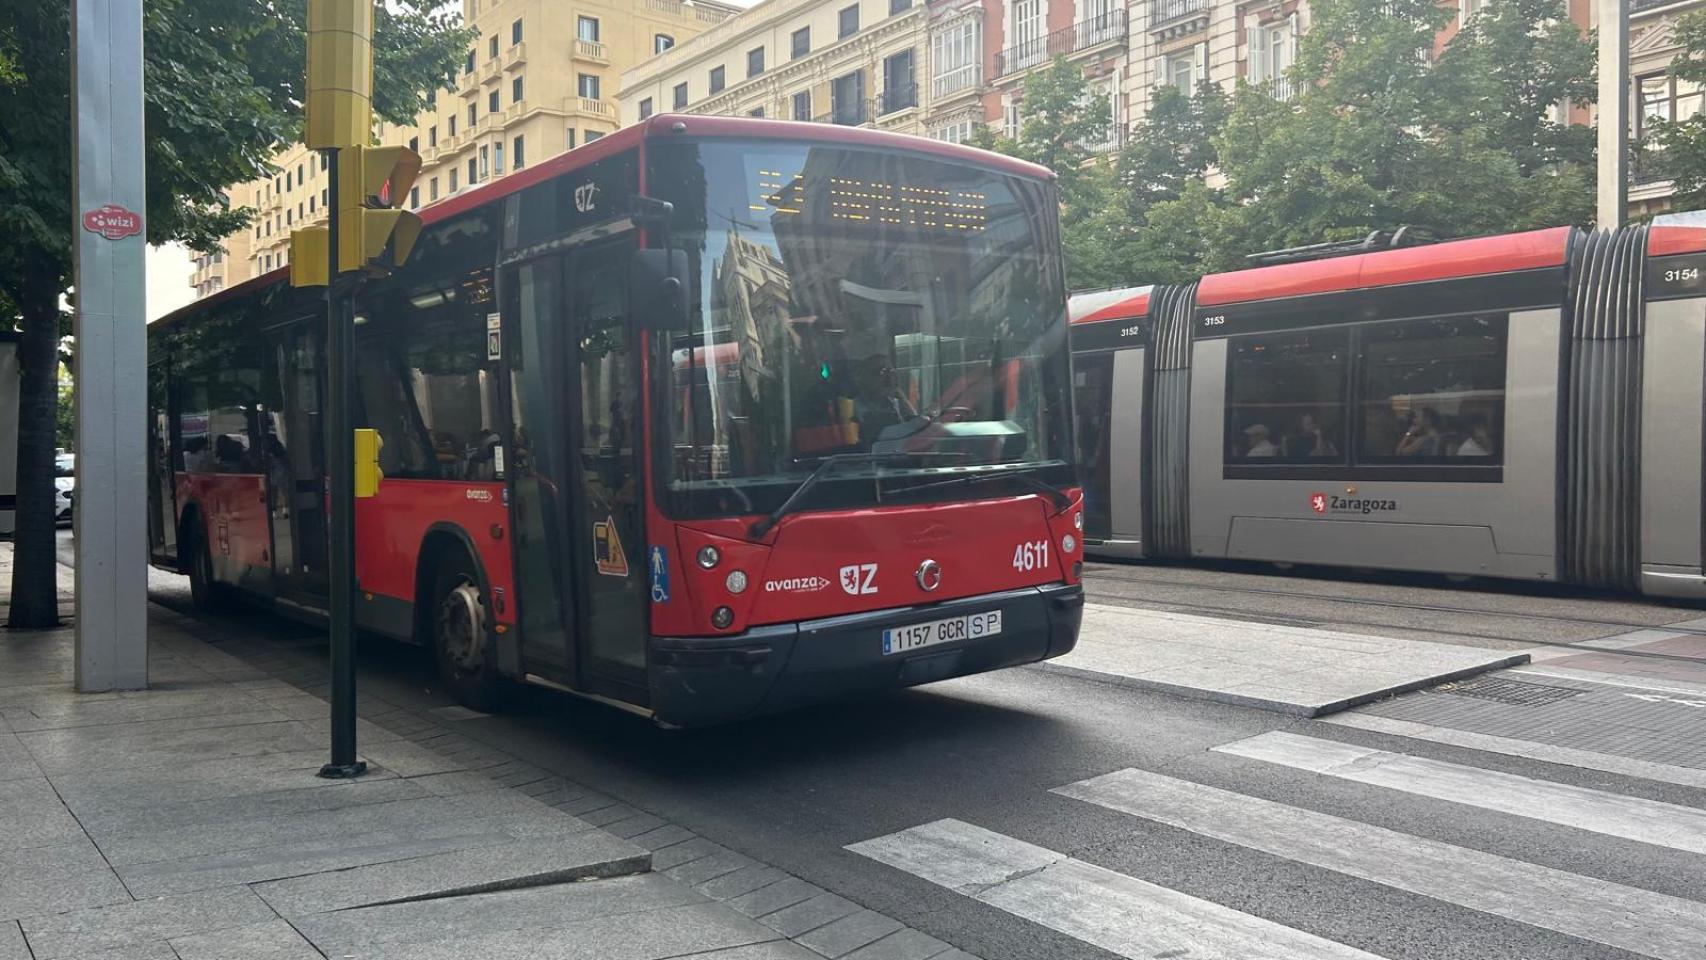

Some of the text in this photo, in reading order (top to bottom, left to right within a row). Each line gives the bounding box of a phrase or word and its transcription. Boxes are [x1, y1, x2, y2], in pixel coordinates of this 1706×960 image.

[107, 216, 133, 228] wizi
[1664, 268, 1698, 282] 3154
[1204, 316, 1225, 326] 3153
[1120, 326, 1138, 337] 3152
[1330, 496, 1396, 514] Zaragoza
[1013, 540, 1048, 572] 4611
[765, 576, 818, 592] avanza
[897, 626, 931, 649] 1157
[937, 620, 965, 641] GCR
